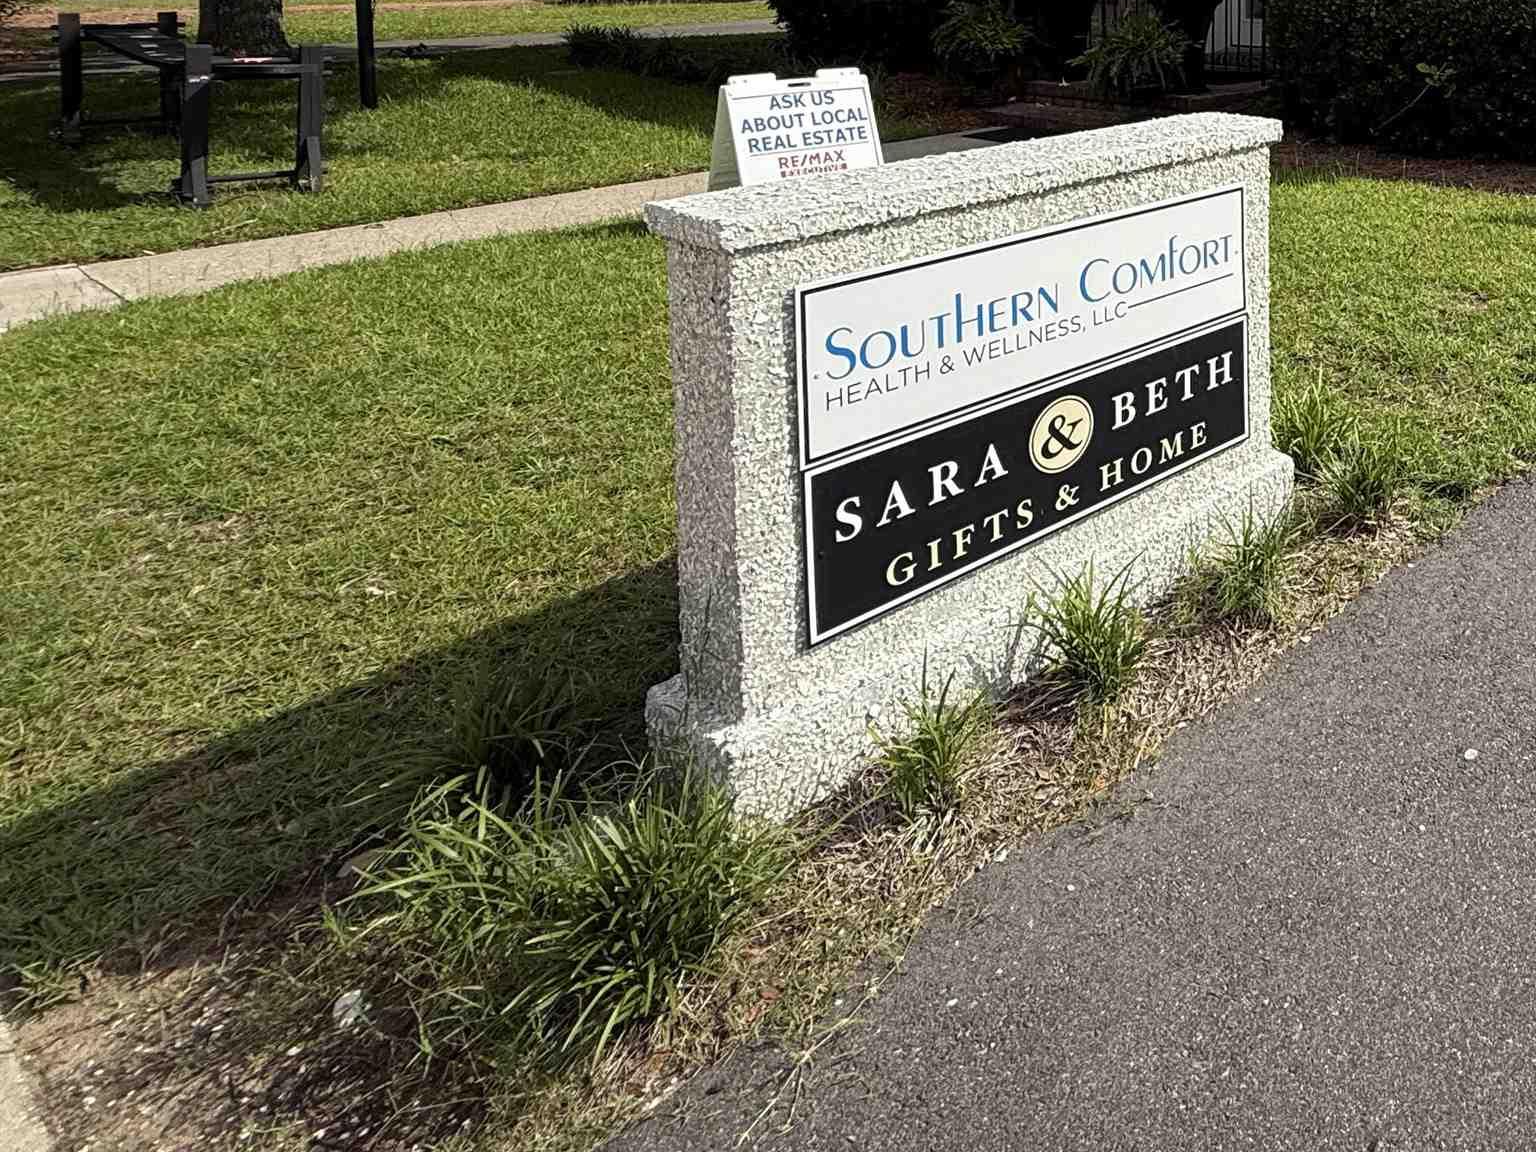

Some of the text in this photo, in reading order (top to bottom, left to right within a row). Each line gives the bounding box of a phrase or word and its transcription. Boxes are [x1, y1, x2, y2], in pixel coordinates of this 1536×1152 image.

[741, 107, 868, 134] ABOUT LOCAL
[769, 90, 835, 111] ASK US
[747, 126, 868, 153] REAL ESTATE
[778, 149, 846, 169] RE/MAX
[825, 283, 1059, 380] SOUTHERN
[825, 301, 1128, 411] HEALTH & WELLNESS, LLC
[835, 351, 1233, 543] SARA & BETH
[886, 422, 1208, 586] GIFTS & HOME
